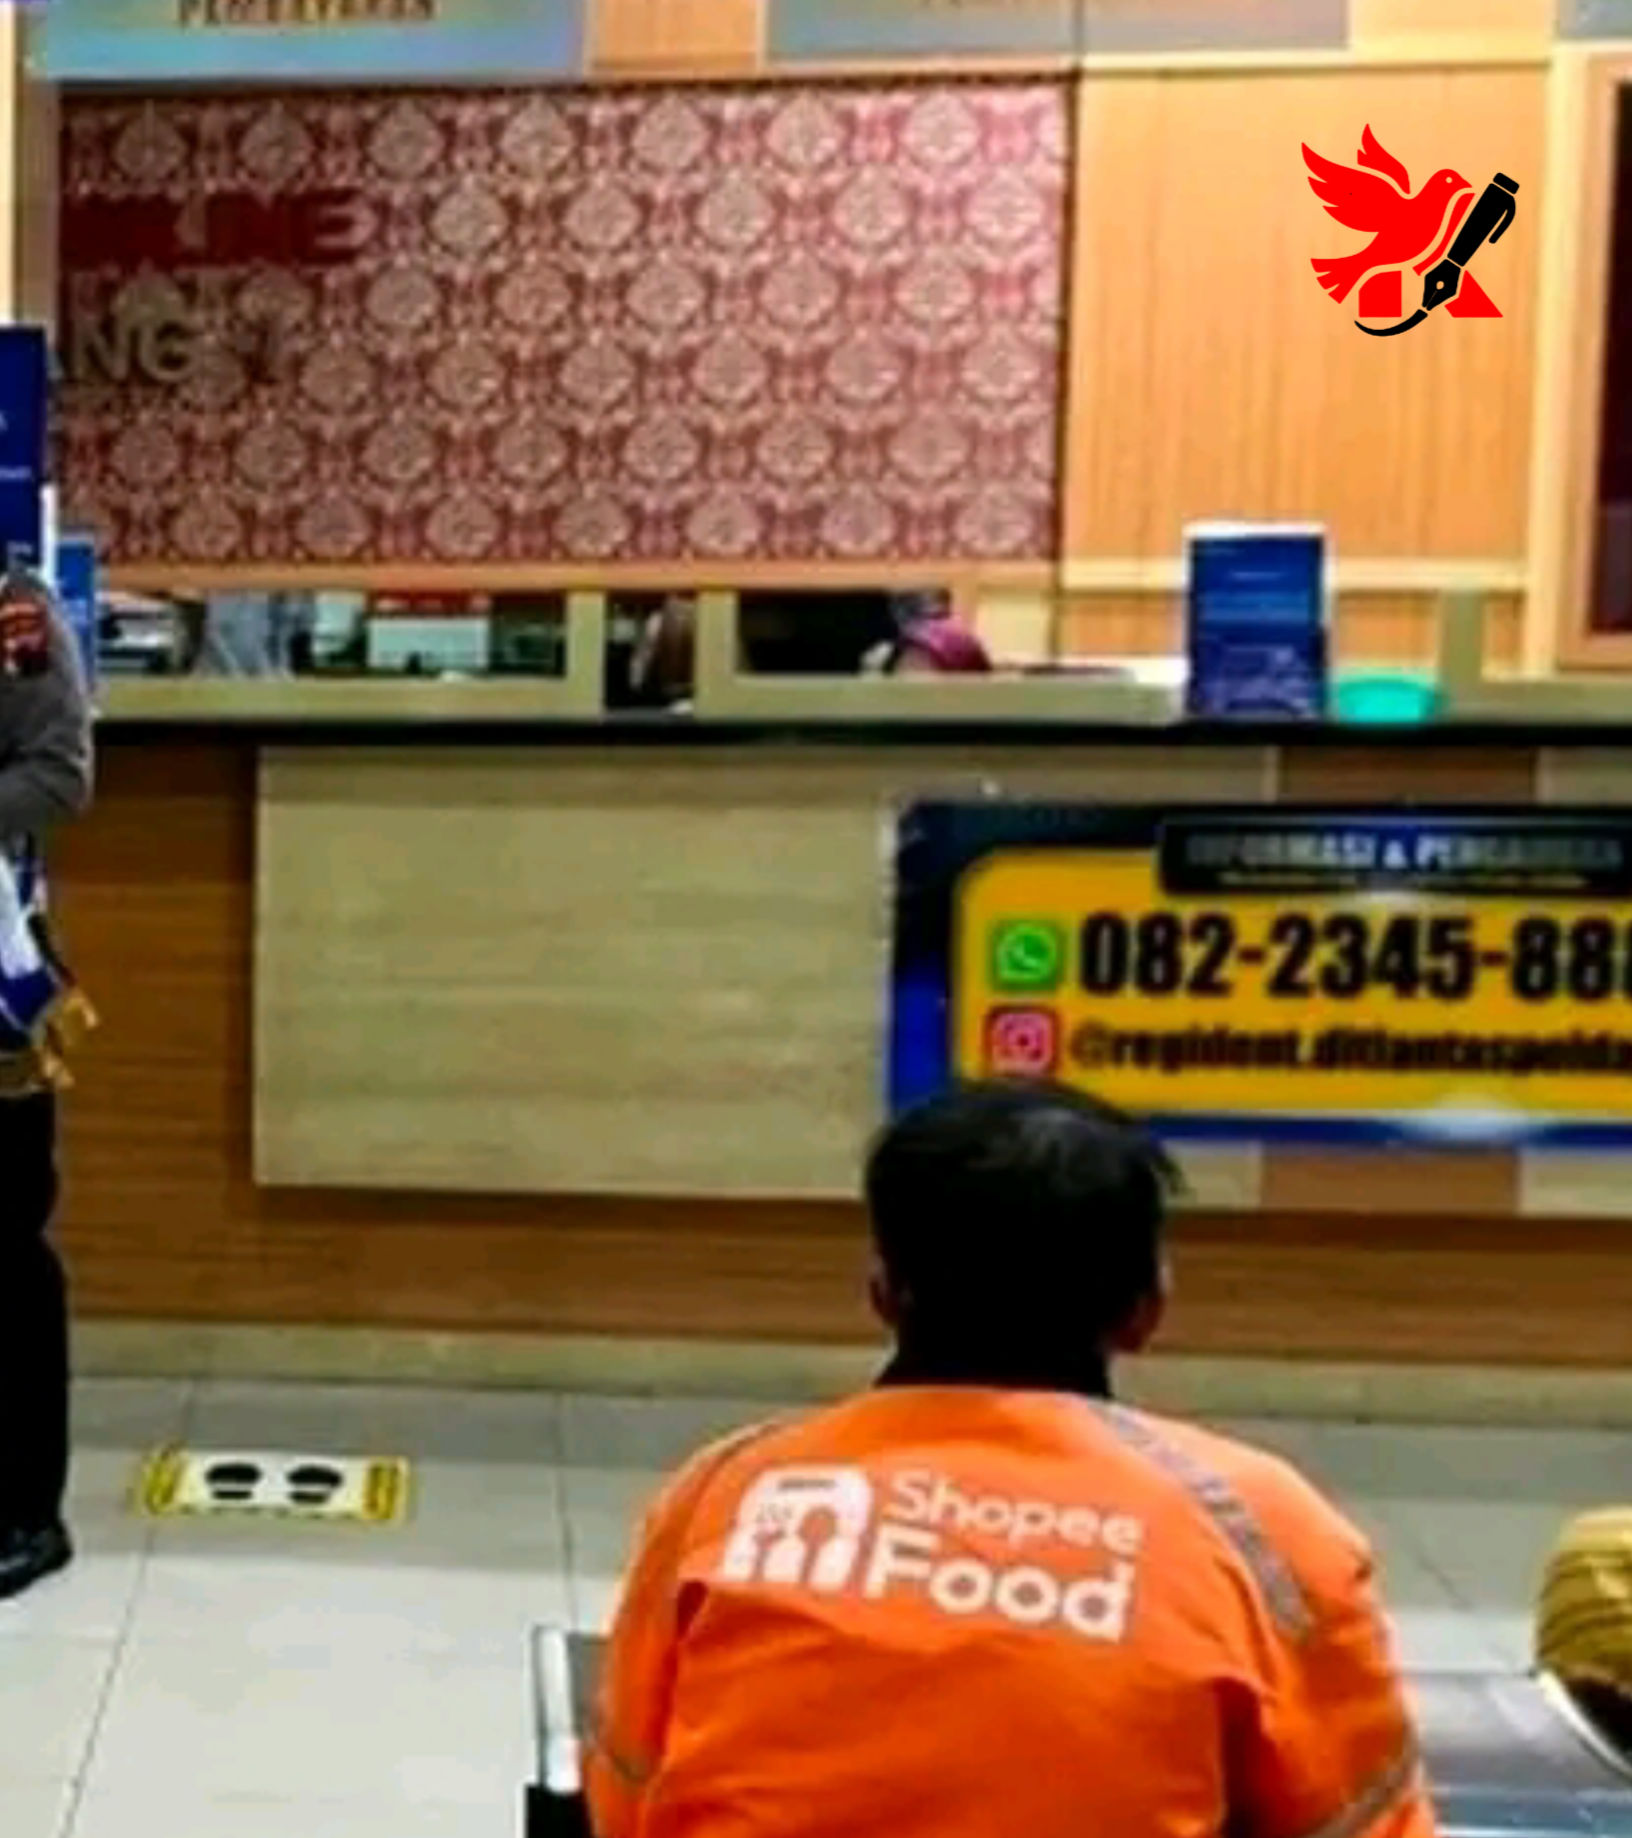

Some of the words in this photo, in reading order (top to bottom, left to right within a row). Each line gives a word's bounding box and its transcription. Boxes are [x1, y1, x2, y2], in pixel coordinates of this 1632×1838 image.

[1079, 911, 1632, 1000] 082-2345-88
[884, 1468, 1144, 1555] Shopee
[862, 1521, 1138, 1645] Food
